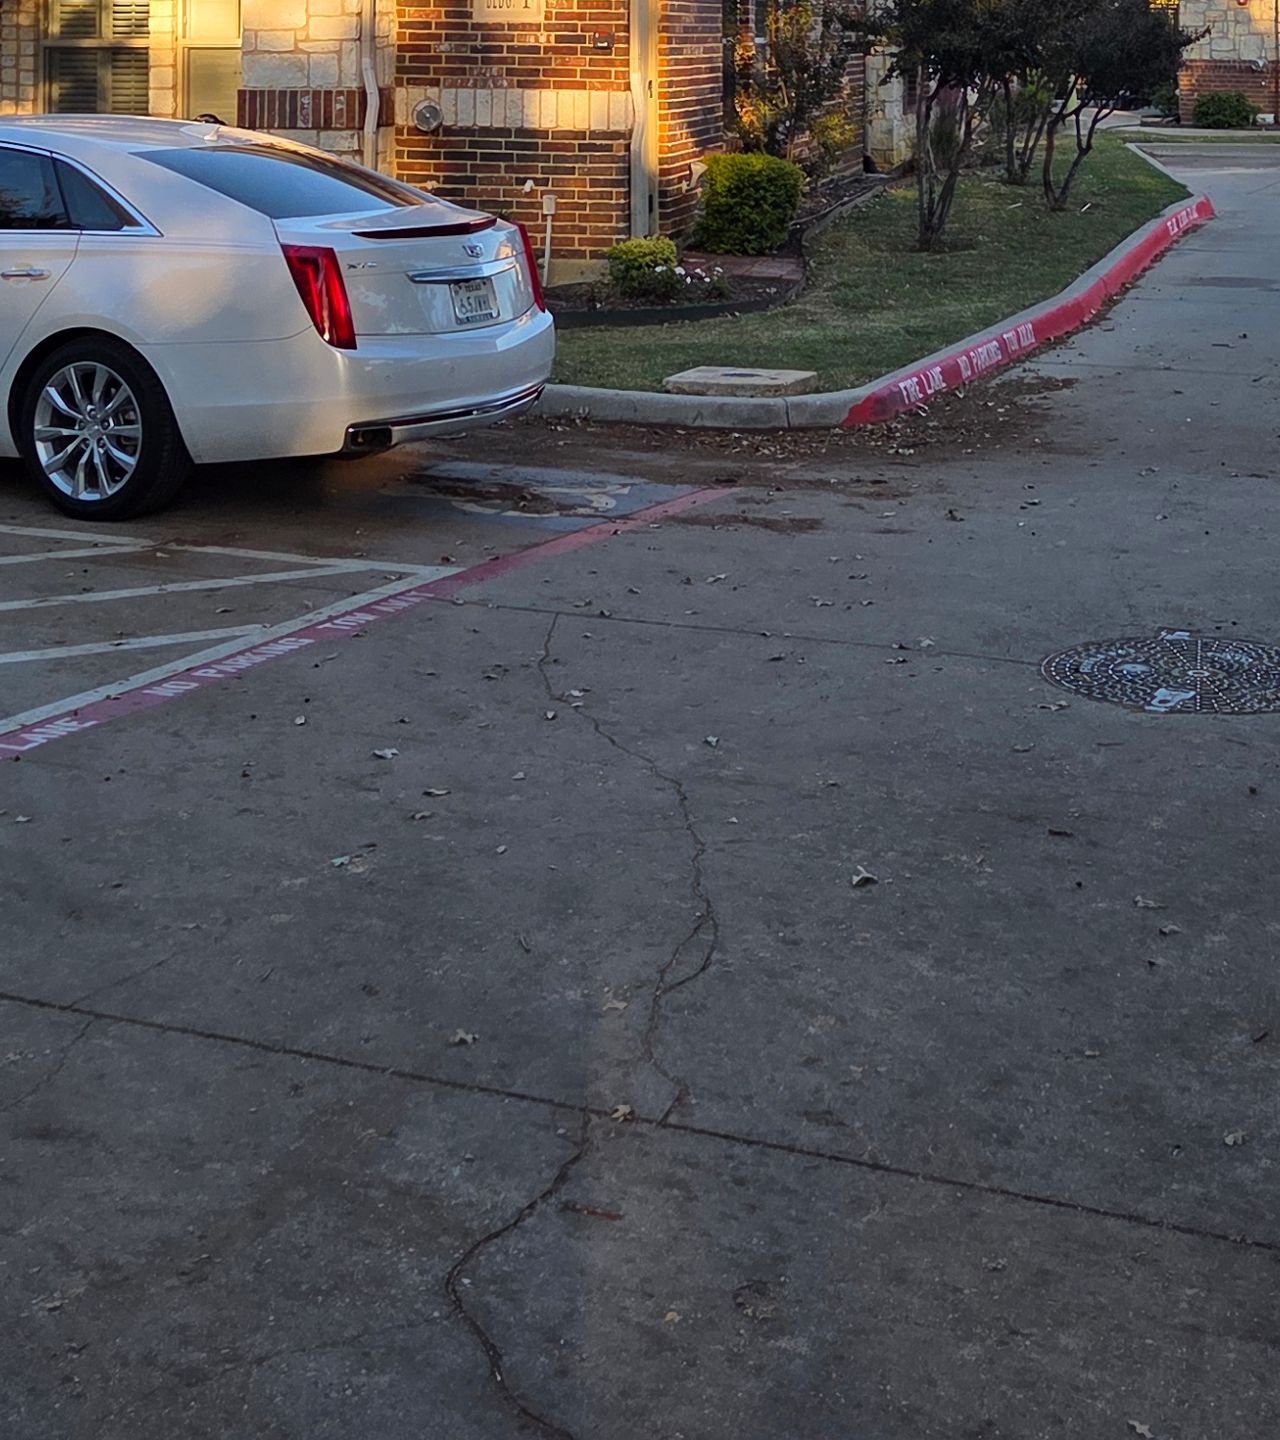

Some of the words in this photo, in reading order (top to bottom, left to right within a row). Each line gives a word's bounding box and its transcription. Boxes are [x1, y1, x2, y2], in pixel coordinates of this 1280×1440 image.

[898, 376, 923, 405] FIRE
[920, 366, 947, 395] LANE
[956, 355, 971, 380] NO
[970, 340, 1002, 374] PARKING
[142, 680, 200, 697] NO
[191, 637, 315, 678] PARKING
[315, 612, 380, 630] TOW
[370, 591, 435, 613] AWAY
